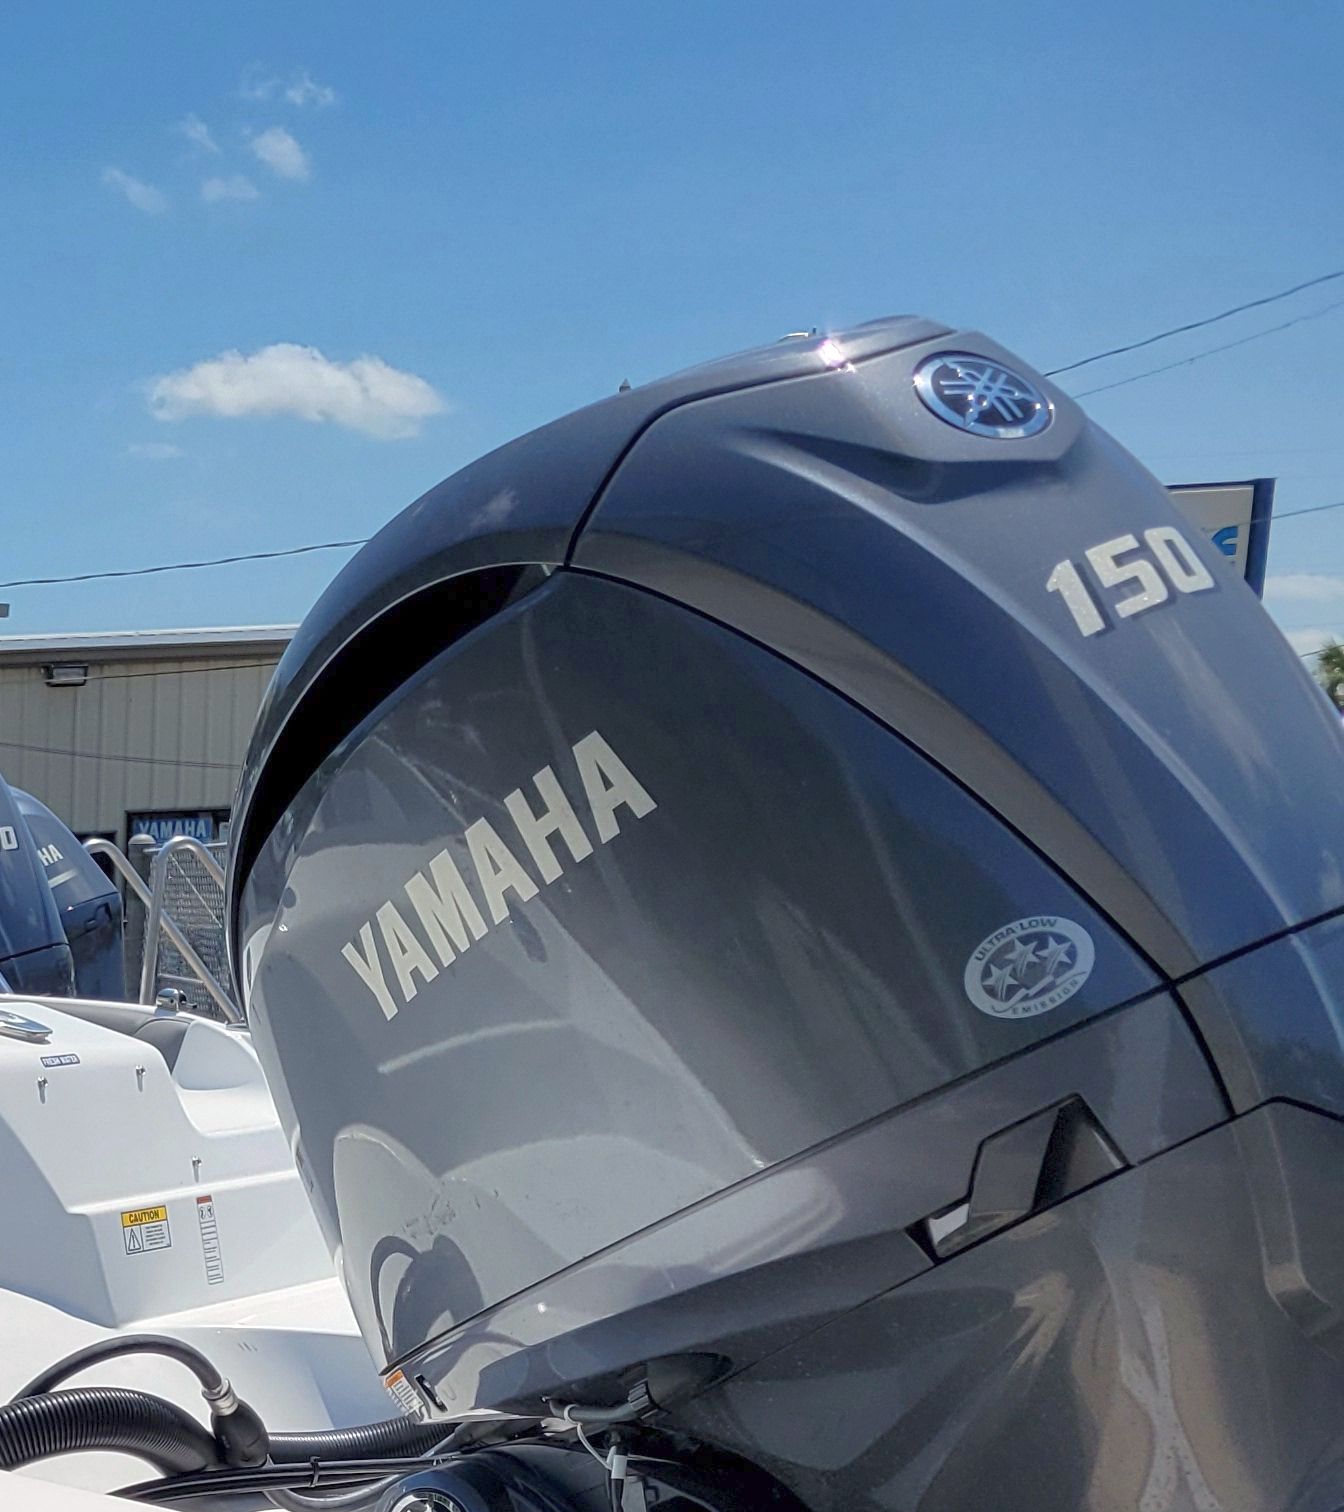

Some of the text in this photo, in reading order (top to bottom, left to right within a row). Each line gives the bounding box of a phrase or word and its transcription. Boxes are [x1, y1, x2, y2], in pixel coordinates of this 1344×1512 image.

[1047, 526, 1215, 637] 150
[139, 820, 207, 838] YAMAHA
[342, 731, 655, 1021] YAMAHA
[128, 1209, 160, 1224] CAUTION
